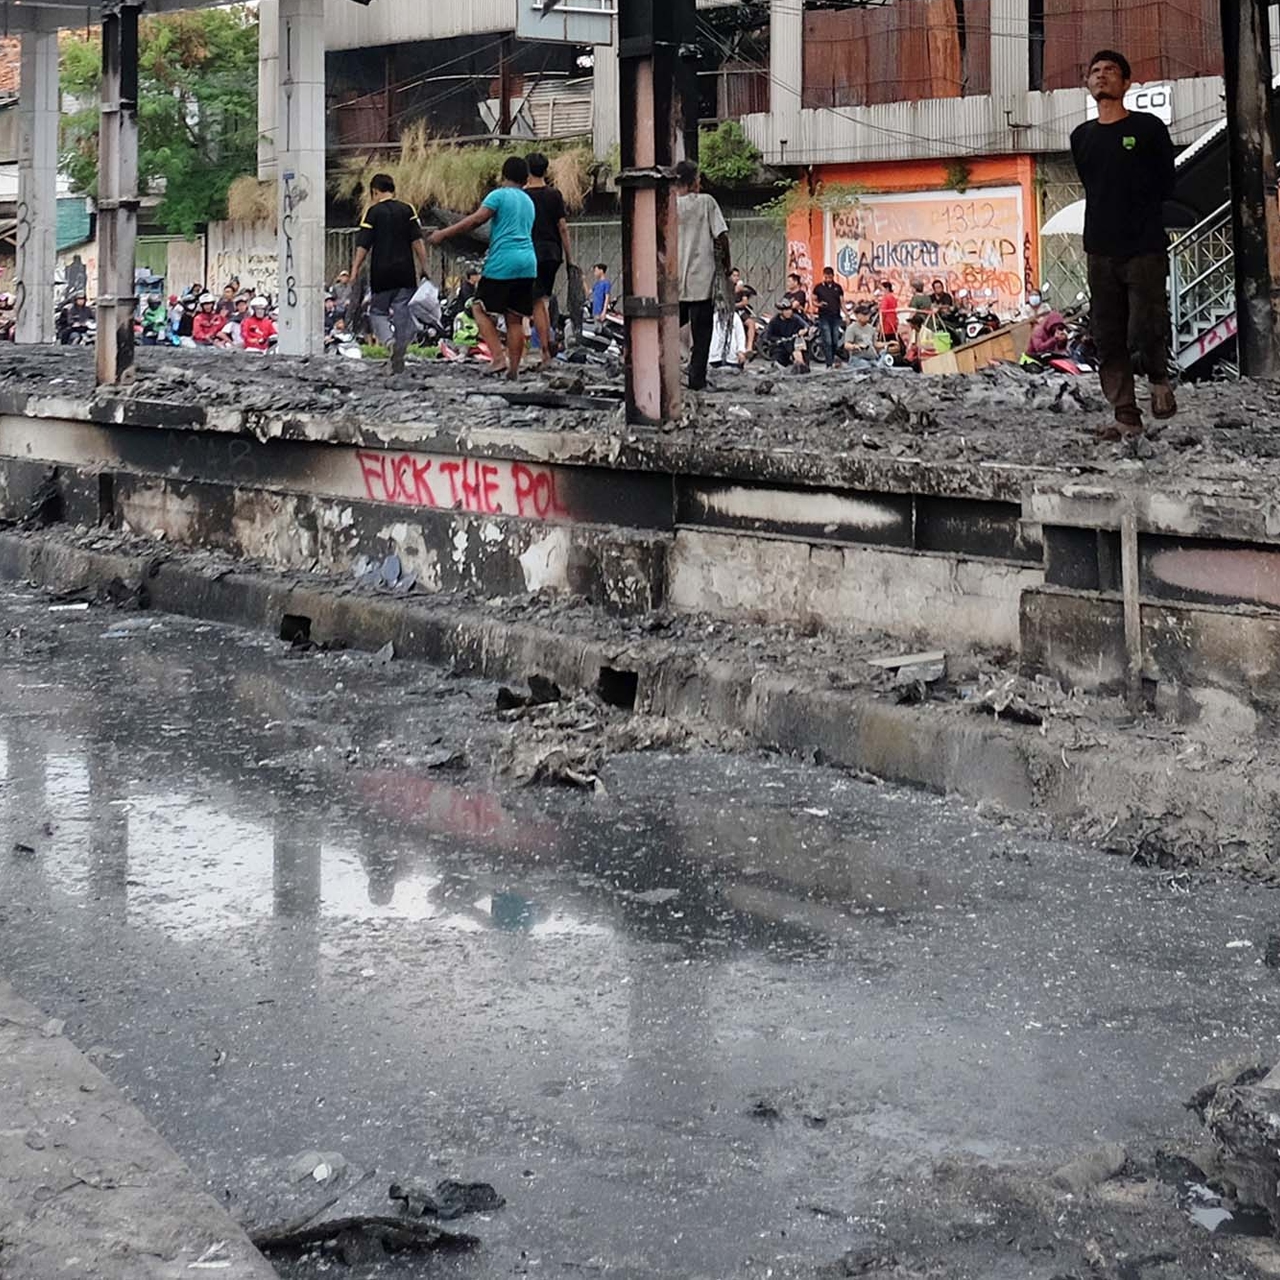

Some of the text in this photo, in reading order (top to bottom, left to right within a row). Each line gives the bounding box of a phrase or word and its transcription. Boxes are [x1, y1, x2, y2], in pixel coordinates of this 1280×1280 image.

[941, 201, 1001, 234] 1312
[356, 450, 436, 507] FUCK
[438, 459, 503, 514] THE
